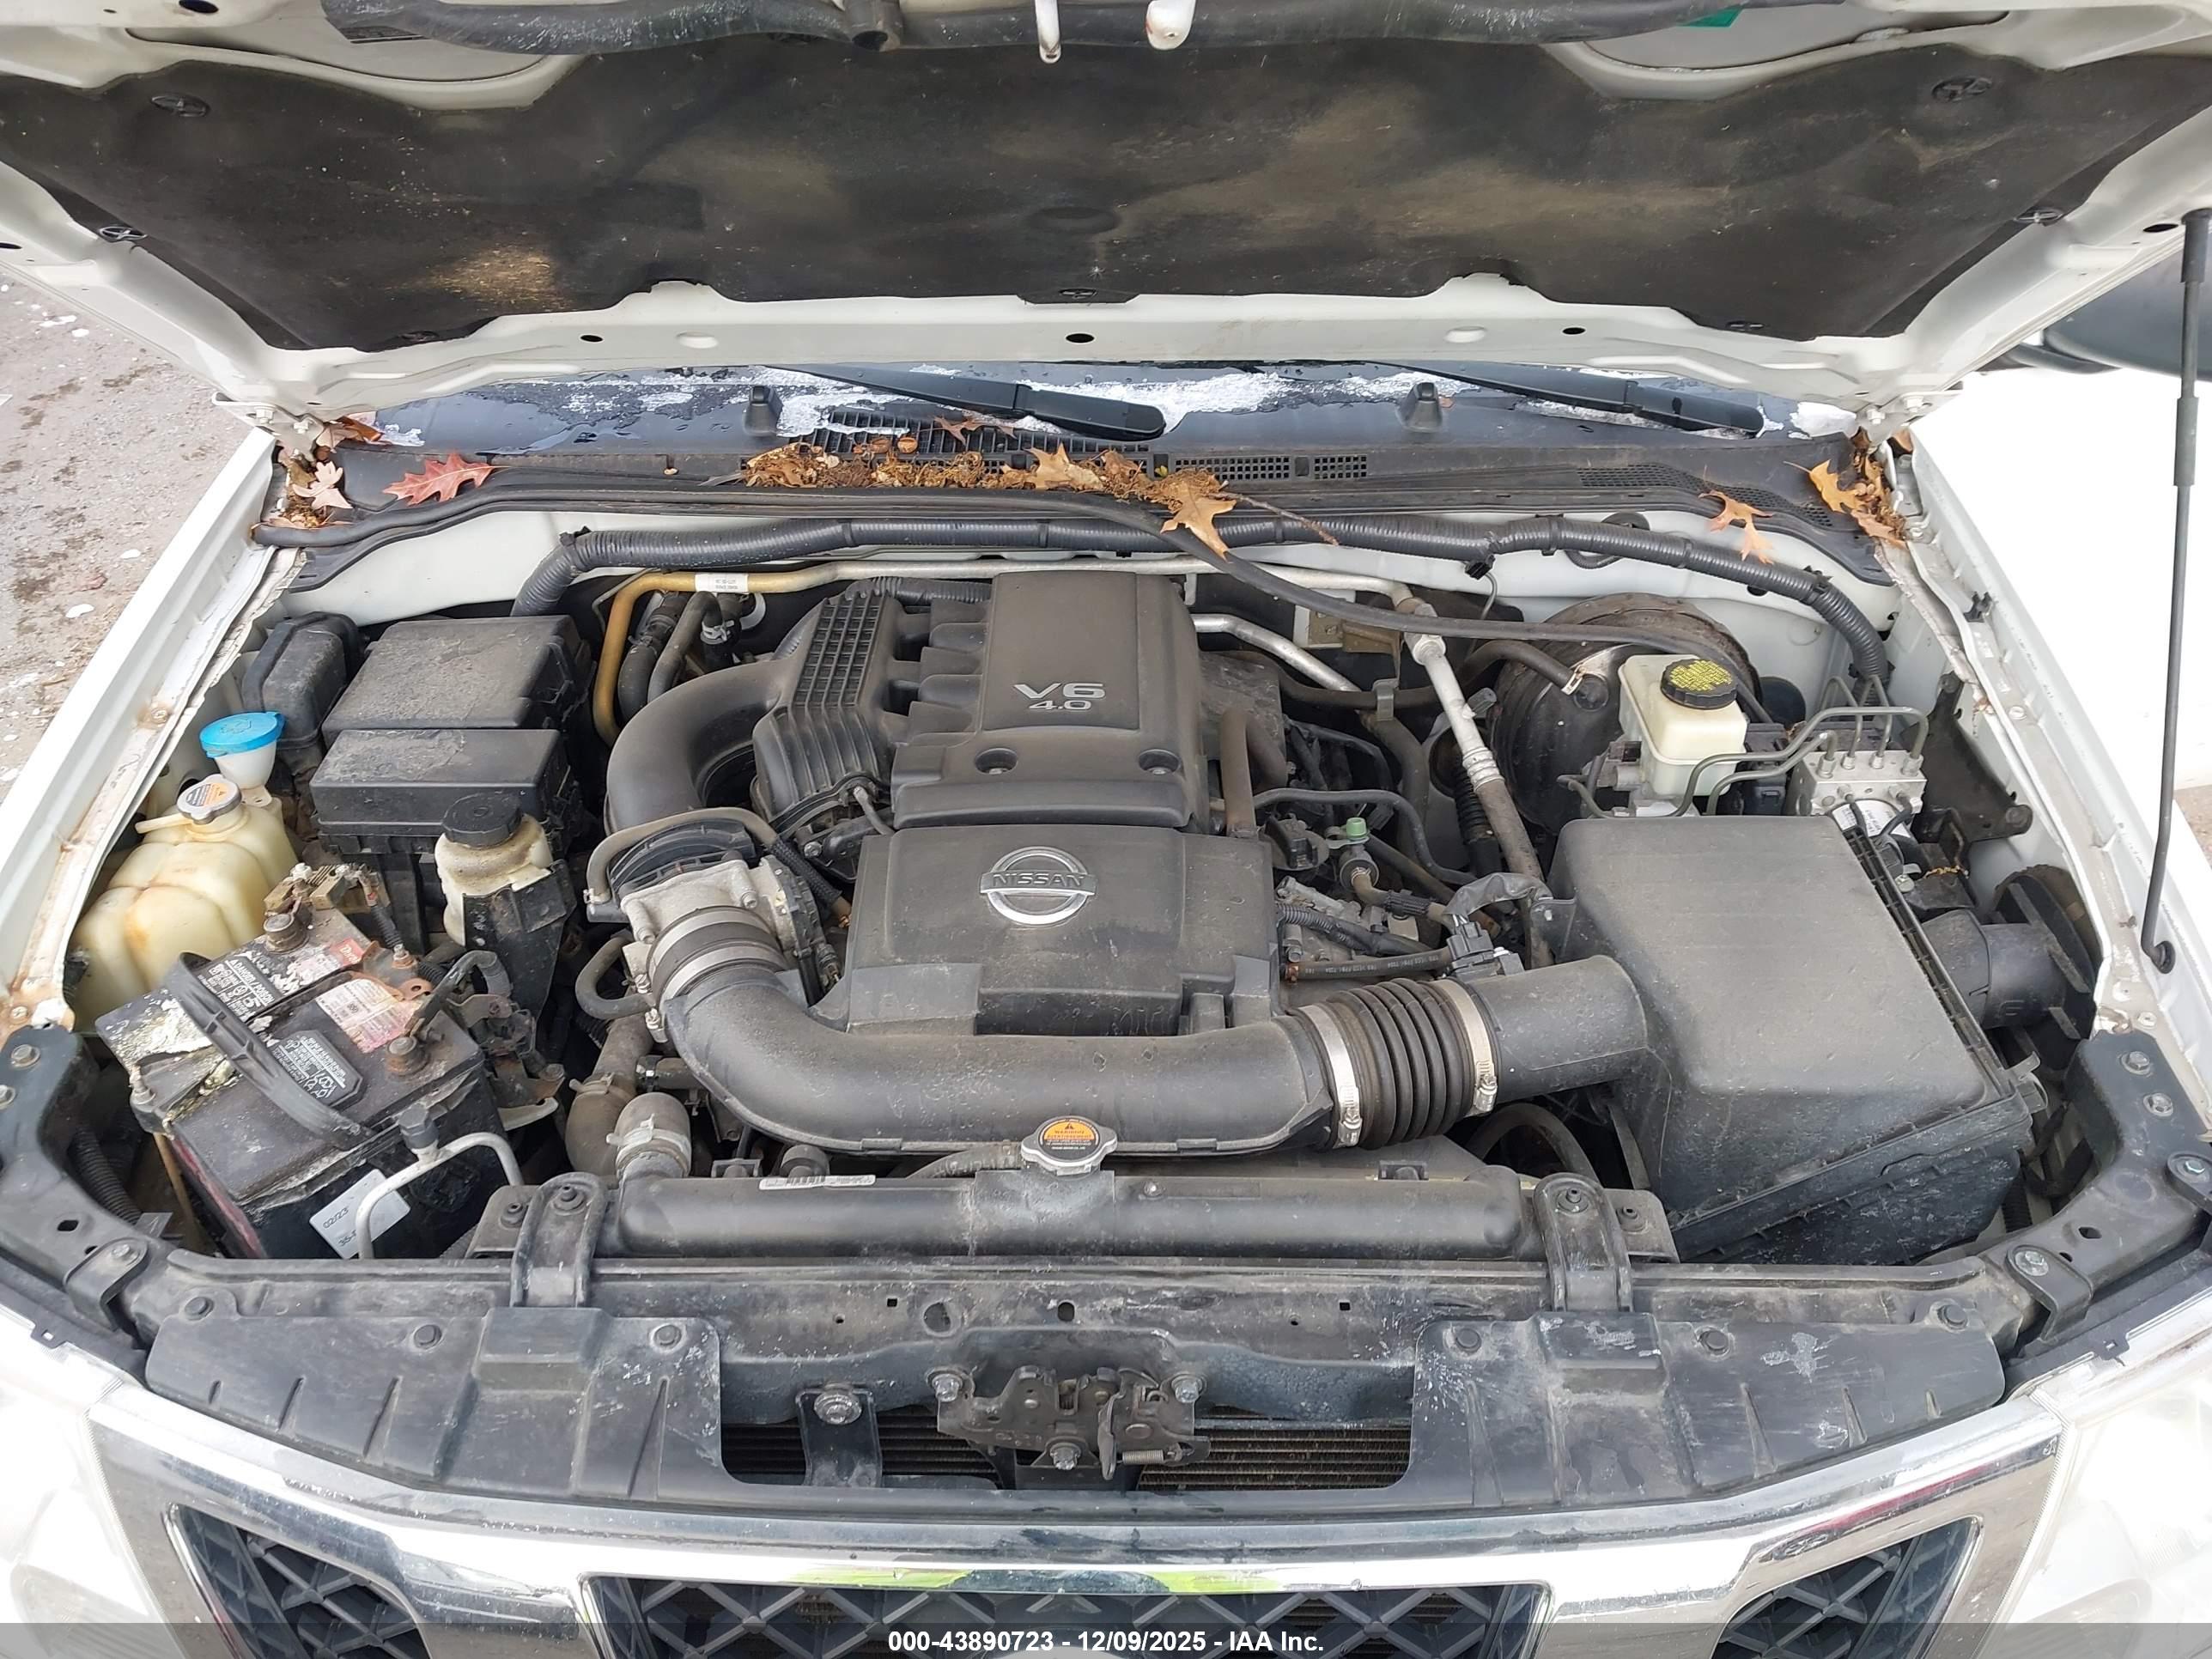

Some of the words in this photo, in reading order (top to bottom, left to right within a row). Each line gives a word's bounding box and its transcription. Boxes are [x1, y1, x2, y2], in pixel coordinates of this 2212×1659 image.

[1013, 683, 1106, 699] V6
[1029, 700, 1091, 710] 4.0
[993, 872, 1085, 887] NISSAN
